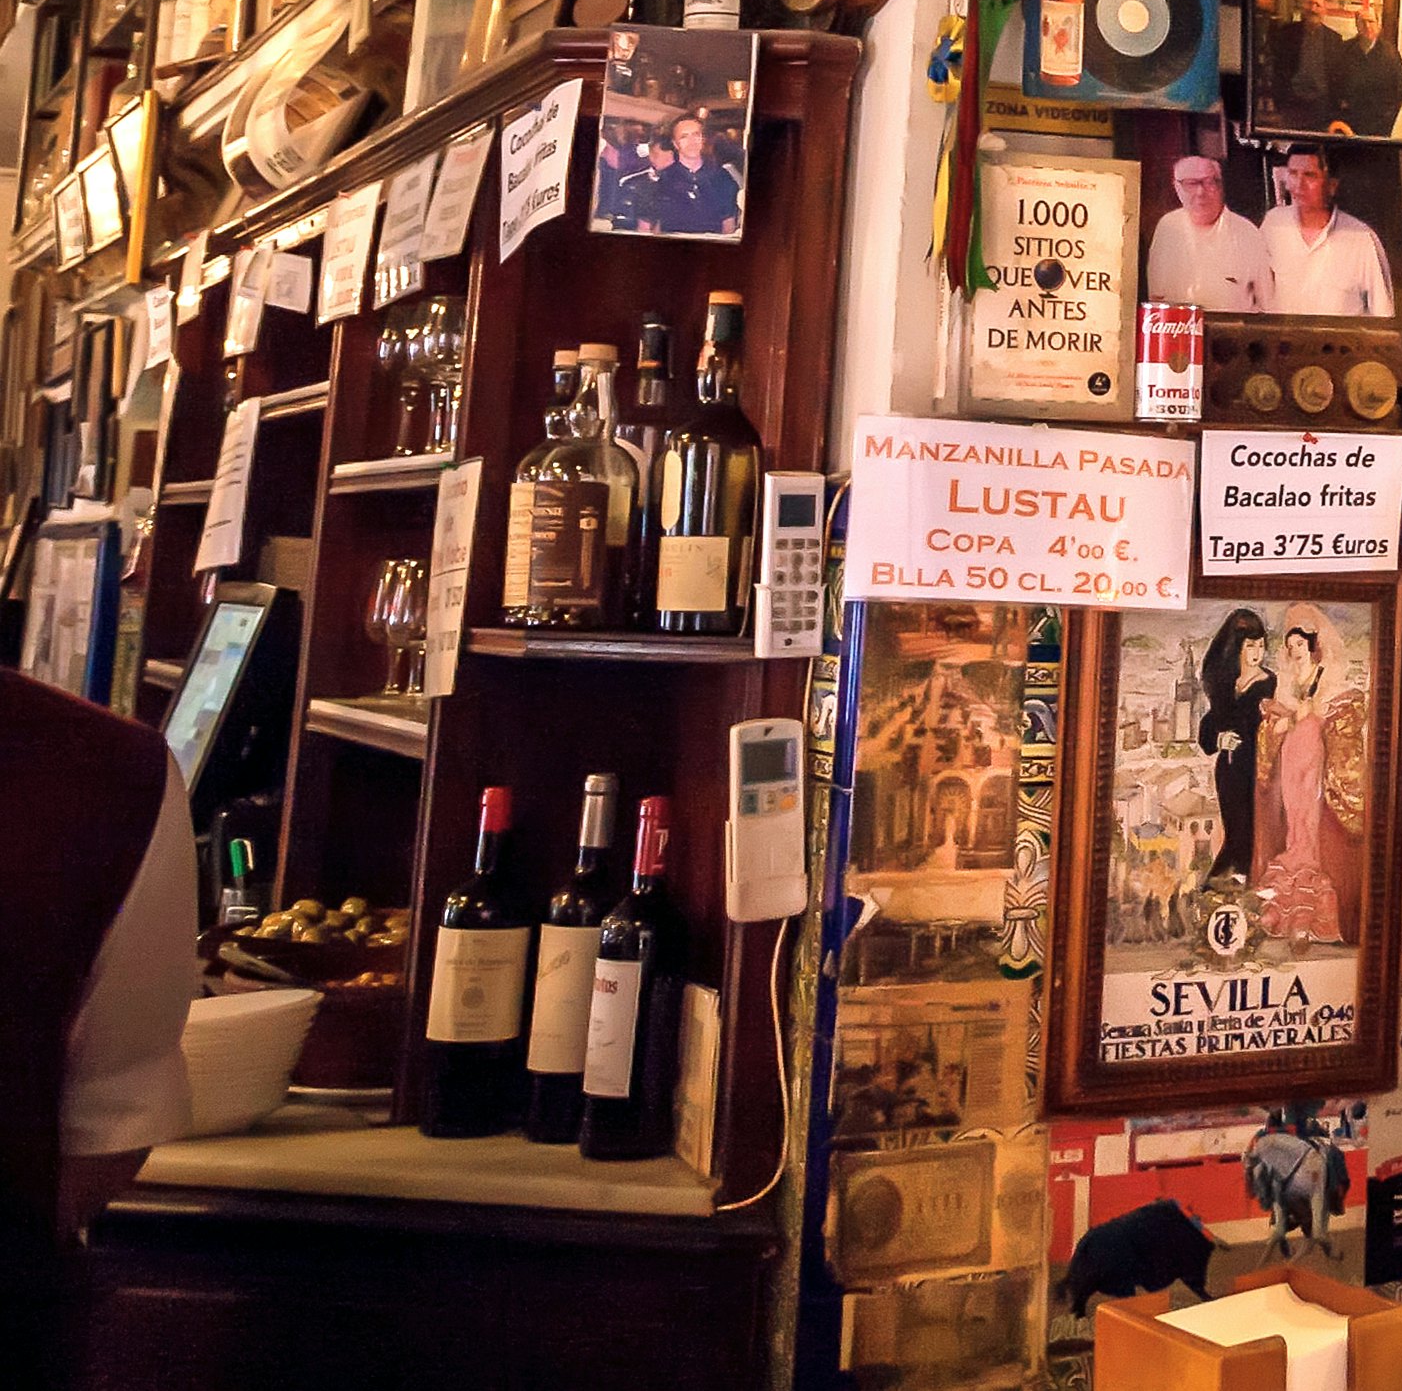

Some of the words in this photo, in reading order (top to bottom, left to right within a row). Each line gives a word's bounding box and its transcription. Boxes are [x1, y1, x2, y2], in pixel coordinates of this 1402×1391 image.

[986, 100, 1029, 116] ZONA
[1017, 198, 1089, 228] 1.000
[1013, 235, 1086, 259] SITIOS
[984, 265, 1032, 291] QUE
[1064, 270, 1112, 293] VER
[1008, 298, 1087, 321] ANTES
[987, 328, 1021, 349] DE
[1026, 330, 1103, 353] MORIR
[1147, 384, 1201, 400] Tomato
[864, 435, 1069, 471] MANZANILLA
[1078, 449, 1194, 482] PASADA
[1230, 444, 1338, 469] Cocochas
[1345, 445, 1376, 470] de
[948, 479, 1127, 523] LUSTAU
[1223, 484, 1312, 509] Bacalao
[1319, 485, 1377, 509] fritas
[926, 528, 1016, 556] COPA
[1208, 535, 1266, 561] Tapa
[1272, 535, 1324, 557] 3'75
[871, 561, 957, 590] BLLA
[966, 566, 1009, 590] 50
[1150, 975, 1311, 1016] SEVILLA
[1244, 1011, 1265, 1028] de
[1270, 1006, 1308, 1028] Abril
[1101, 1037, 1187, 1061] FIESTAS
[1195, 1022, 1352, 1054] PRIMAVERALES
